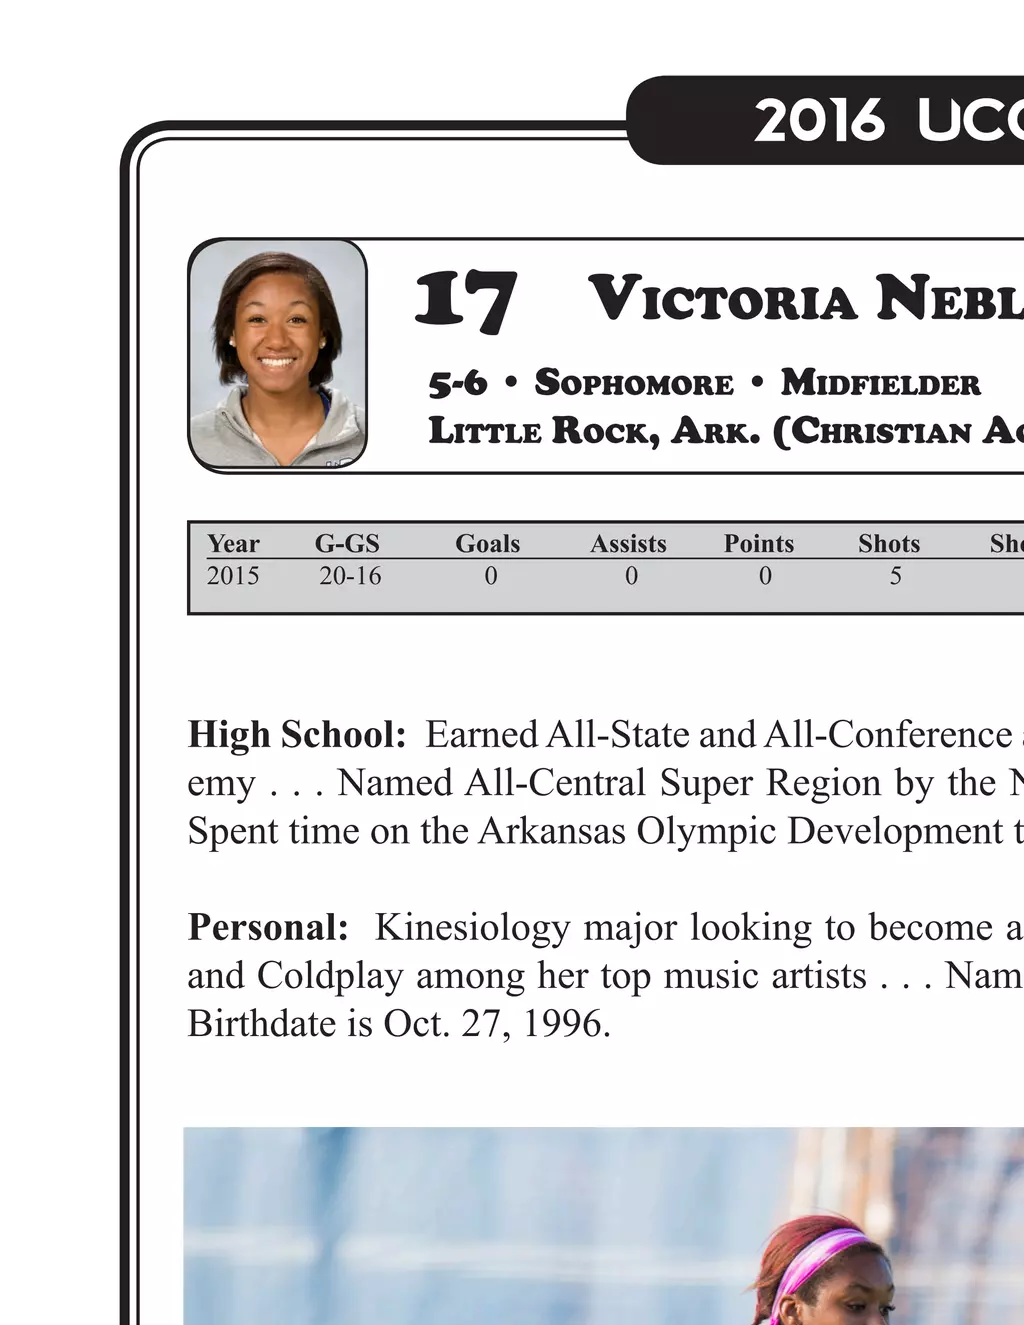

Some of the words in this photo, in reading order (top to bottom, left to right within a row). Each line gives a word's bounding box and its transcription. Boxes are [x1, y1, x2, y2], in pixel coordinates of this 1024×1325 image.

[753, 97, 886, 142] 2016
[414, 268, 518, 336] 17
[428, 368, 488, 400] 5-6
[207, 533, 261, 553] Year
[315, 533, 380, 554] G-GS
[455, 533, 521, 554] Goals
[590, 533, 667, 553] Assists
[724, 533, 795, 553] Points
[858, 533, 921, 554] Shots
[207, 565, 259, 586] 2015
[319, 565, 382, 586] 20-16
[484, 565, 498, 586] 0
[625, 565, 638, 586] 0
[759, 565, 772, 586] 0
[890, 566, 902, 585] 5
[187, 719, 271, 757] High
[281, 719, 405, 749] School:
[425, 718, 539, 749] Earned
[545, 718, 690, 749] All-State
[699, 718, 757, 749] and
[763, 718, 1013, 749] All-Conference
[187, 776, 257, 805] emy
[336, 766, 454, 797] Named
[463, 766, 646, 797] All-Central
[661, 767, 754, 805] Super
[766, 766, 882, 805] Region
[894, 766, 935, 805] by
[947, 766, 996, 797] the
[188, 815, 279, 853] Spent
[288, 814, 360, 845] time
[370, 824, 410, 845] on
[420, 815, 469, 845] the
[477, 814, 626, 845] Arkansas
[637, 814, 777, 853] Olympic
[787, 814, 1004, 853] Development
[187, 912, 347, 941] Personal:
[375, 911, 571, 949] Kinesiology
[583, 911, 678, 949] major
[690, 911, 813, 949] looking
[824, 915, 856, 941] to
[868, 911, 993, 941] become
[1006, 920, 1024, 941] a
[187, 959, 245, 989] and
[257, 959, 405, 998] Coldplay
[416, 968, 526, 998] among
[537, 959, 590, 989] her
[600, 963, 651, 998] top
[663, 959, 759, 990] music
[772, 959, 867, 990] artists
[187, 1007, 336, 1038] Birthdate
[347, 1007, 373, 1038] is
[384, 1008, 450, 1038] Oct.
[461, 1008, 511, 1044] 27,
[526, 1008, 610, 1038] 1996.
